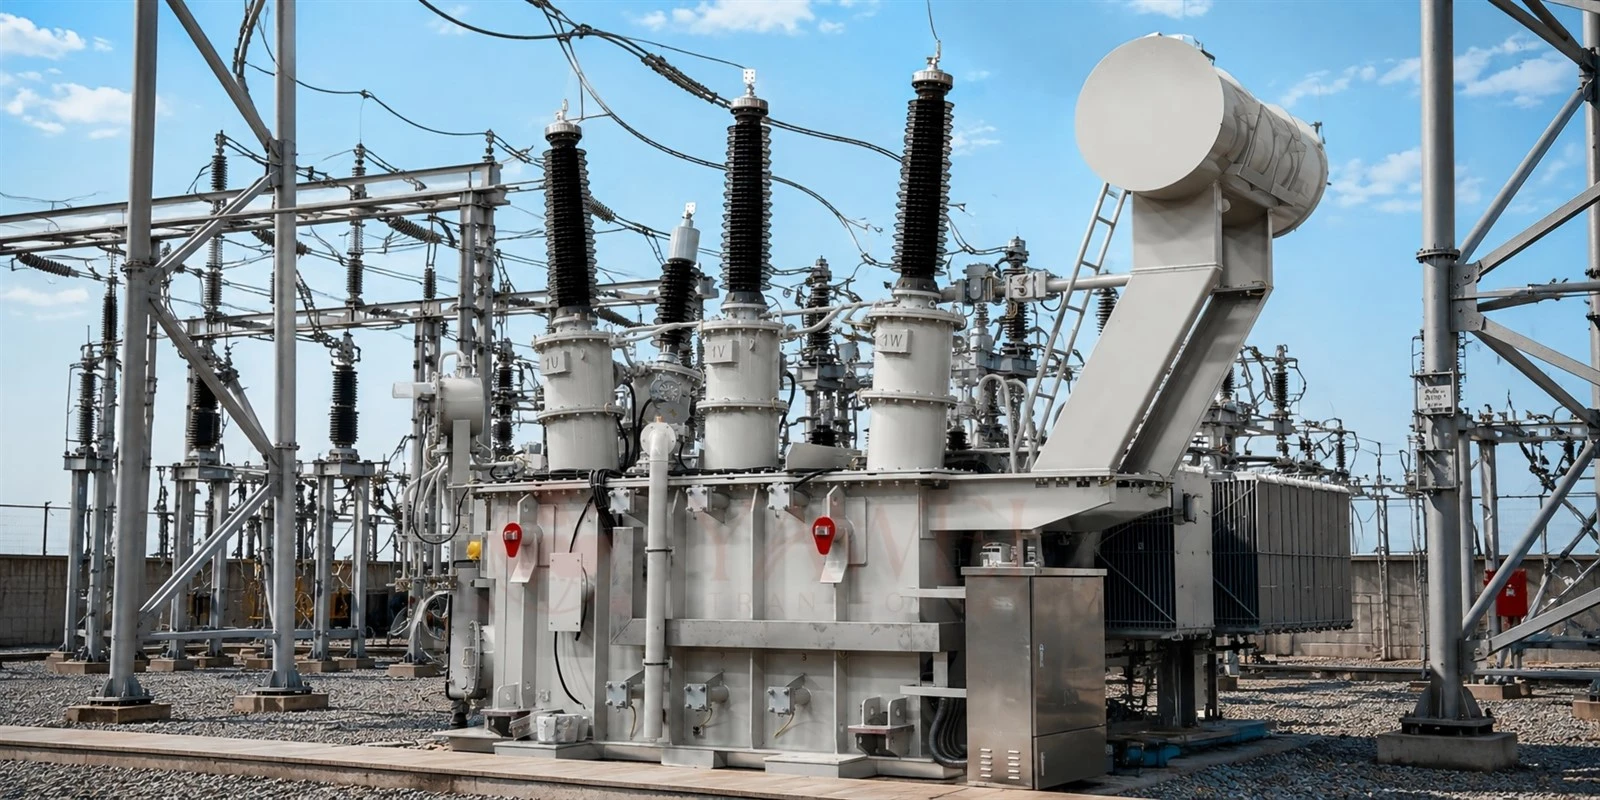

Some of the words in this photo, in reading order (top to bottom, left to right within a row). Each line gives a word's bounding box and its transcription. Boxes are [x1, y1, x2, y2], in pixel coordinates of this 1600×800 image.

[883, 334, 902, 347] 1W
[712, 344, 726, 358] 1V
[545, 356, 558, 370] 1U
